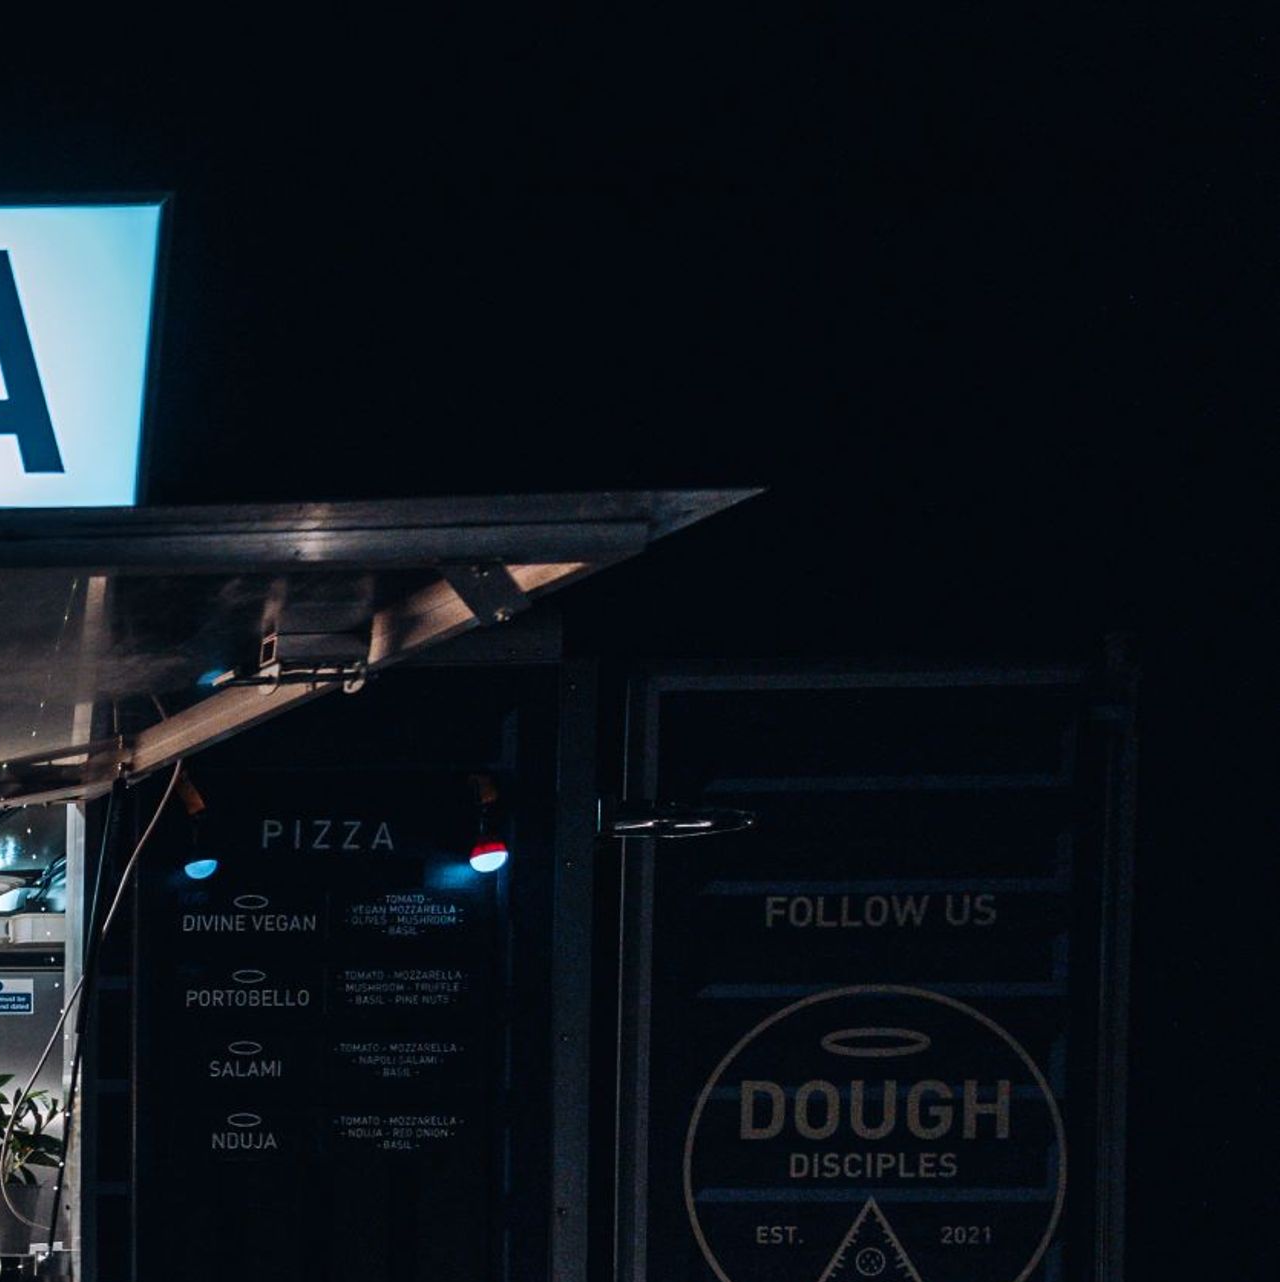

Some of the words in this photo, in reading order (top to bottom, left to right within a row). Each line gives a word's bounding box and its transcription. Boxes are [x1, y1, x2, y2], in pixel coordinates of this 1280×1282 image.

[261, 818, 395, 851] PIZZA
[385, 894, 425, 904] TOMATO
[351, 904, 387, 914] VEGAN
[389, 904, 456, 914] MOZZARELLA
[765, 895, 930, 928] FOLLOW
[944, 894, 998, 927] US
[182, 914, 246, 932] DIVINE
[252, 914, 317, 932] VEGAN
[396, 915, 456, 925] MUSHROOM
[344, 970, 384, 981] TOMATO
[393, 970, 462, 981] MOZZARELLA
[344, 982, 405, 993] MUSHROOM
[186, 989, 311, 1008] PORTOBELLO
[394, 994, 418, 1005] PINE
[339, 1042, 380, 1053] TOMATO
[389, 1042, 457, 1053] MOZZARELLA
[209, 1060, 282, 1079] SALAMI
[739, 1079, 1011, 1141] DOUGH
[340, 1115, 381, 1126] TOMATO
[389, 1115, 457, 1126] MOZZARELLA
[416, 1128, 448, 1138] ONION
[211, 1132, 278, 1151] NDUJA
[788, 1152, 958, 1179] DISCIPLES
[755, 1226, 804, 1245] EST.
[940, 1225, 992, 1245] 2021
